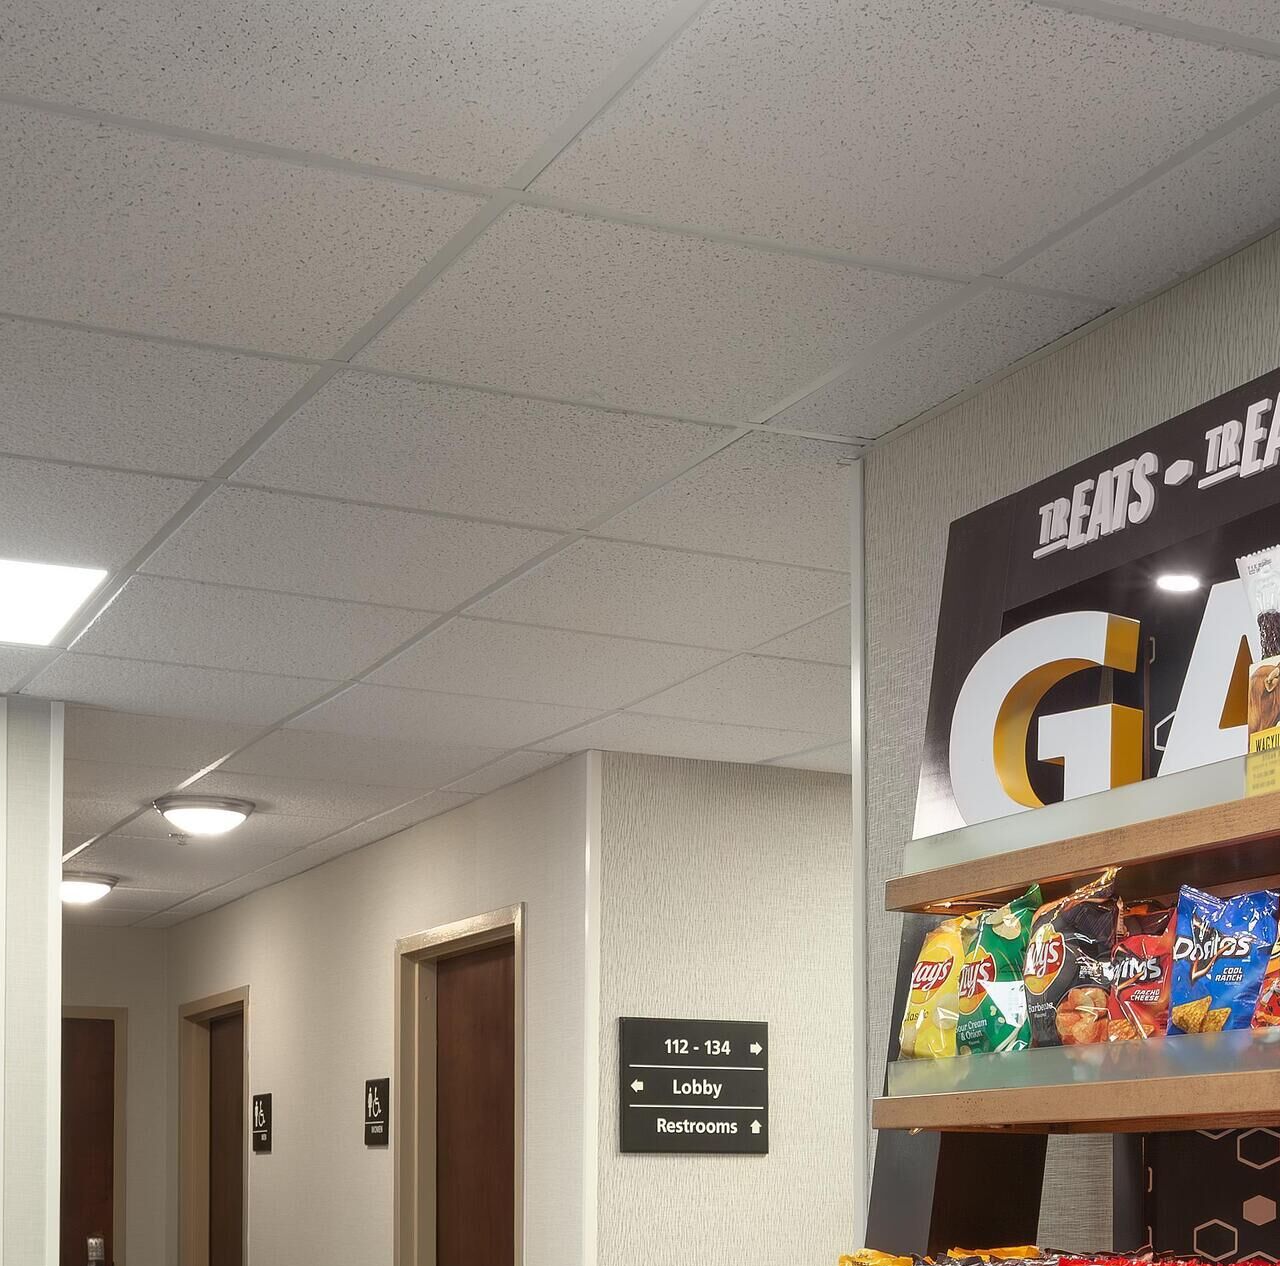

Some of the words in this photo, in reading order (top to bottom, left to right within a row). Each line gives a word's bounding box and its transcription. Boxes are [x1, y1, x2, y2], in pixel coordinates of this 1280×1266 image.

[1036, 451, 1159, 553] TREATS
[1172, 936, 1252, 962] Doritos
[913, 960, 952, 992] Lay's
[1215, 974, 1243, 982] RANCH
[1222, 967, 1243, 975] COOL
[1130, 994, 1160, 1002] CHEESE
[968, 1018, 988, 1030] Cream
[966, 1029, 983, 1041] Onion
[664, 1039, 689, 1054] 112
[704, 1040, 731, 1056] 134
[673, 1079, 722, 1099] Lobby
[656, 1118, 738, 1134] Restrooms
